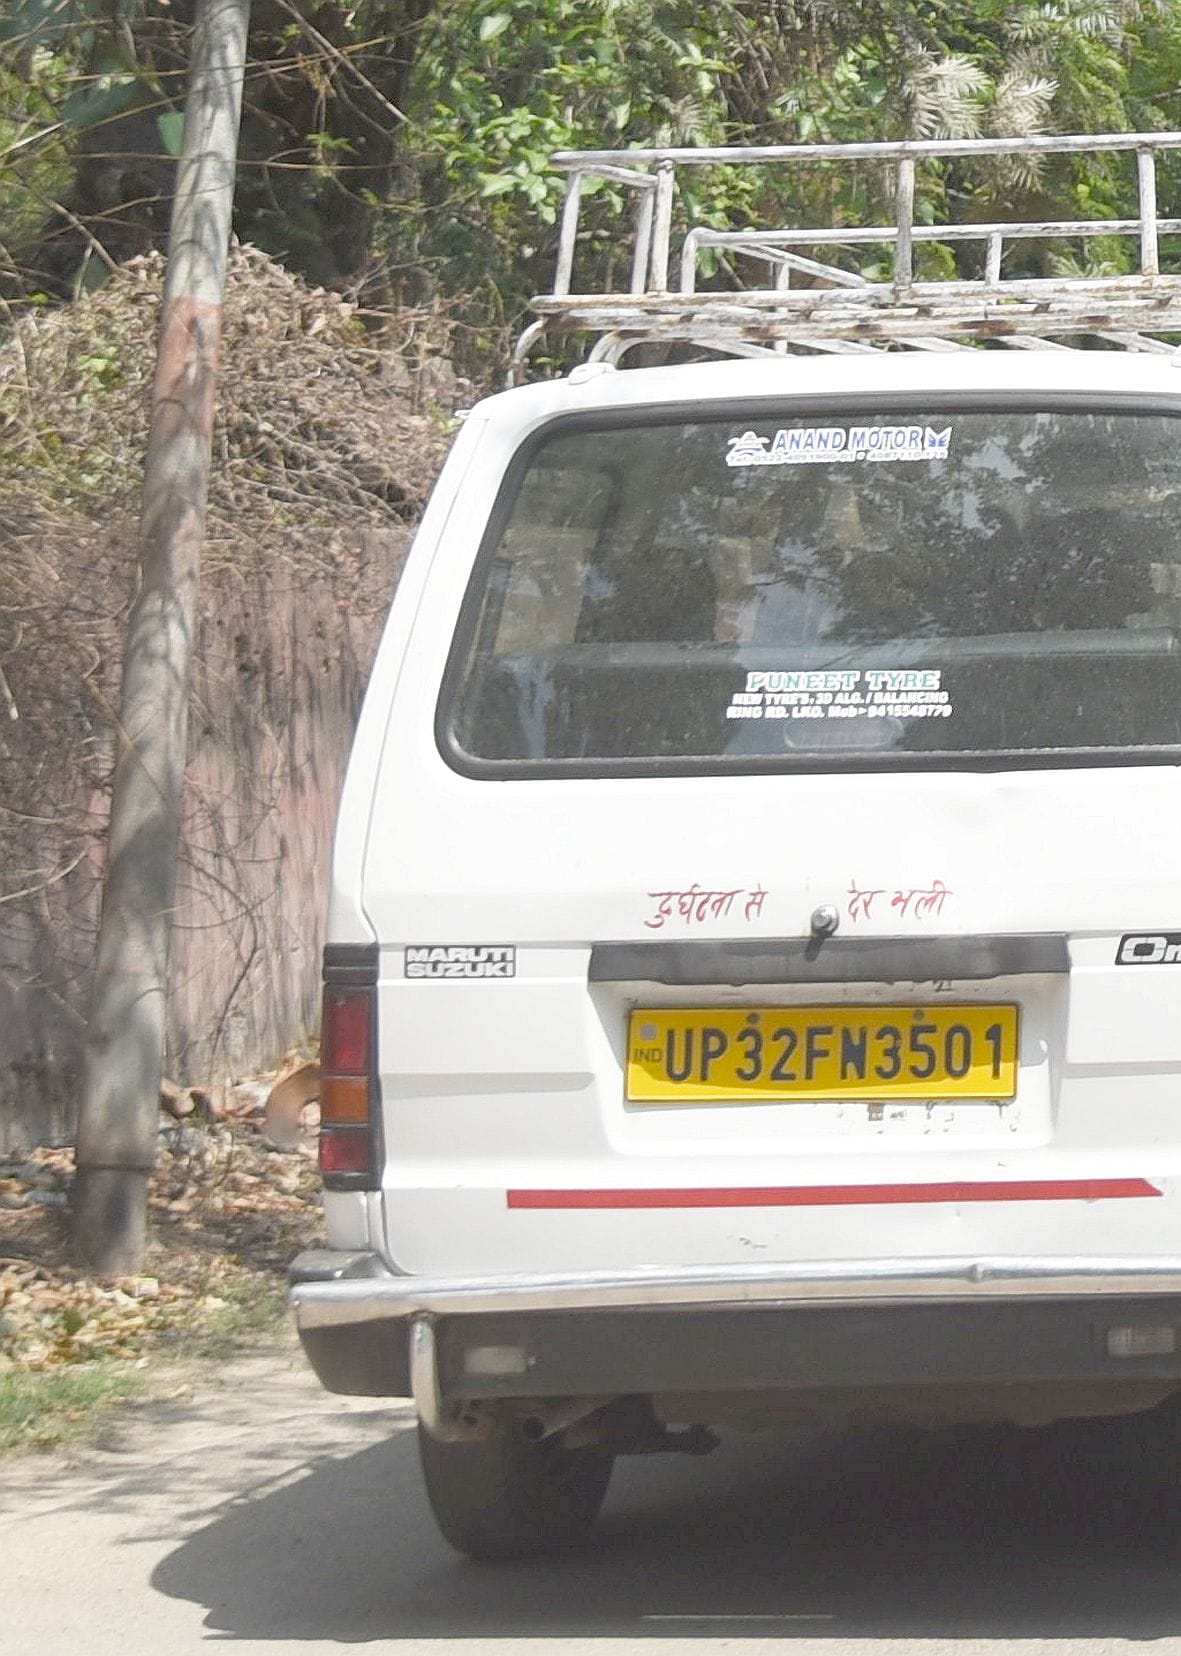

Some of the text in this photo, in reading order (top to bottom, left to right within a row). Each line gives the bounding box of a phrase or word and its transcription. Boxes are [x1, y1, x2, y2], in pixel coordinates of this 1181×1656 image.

[773, 428, 922, 450] ANAND MOTOR
[748, 671, 940, 691] PUNEET TYRE
[873, 691, 949, 704] BALANCING
[744, 883, 769, 921] से
[847, 879, 887, 922] देर
[891, 879, 954, 920] भली
[406, 947, 514, 962] MARUTI
[406, 962, 514, 977] SUZUKI
[634, 1047, 663, 1063] IND
[666, 1024, 1003, 1082] UP32FN3501
